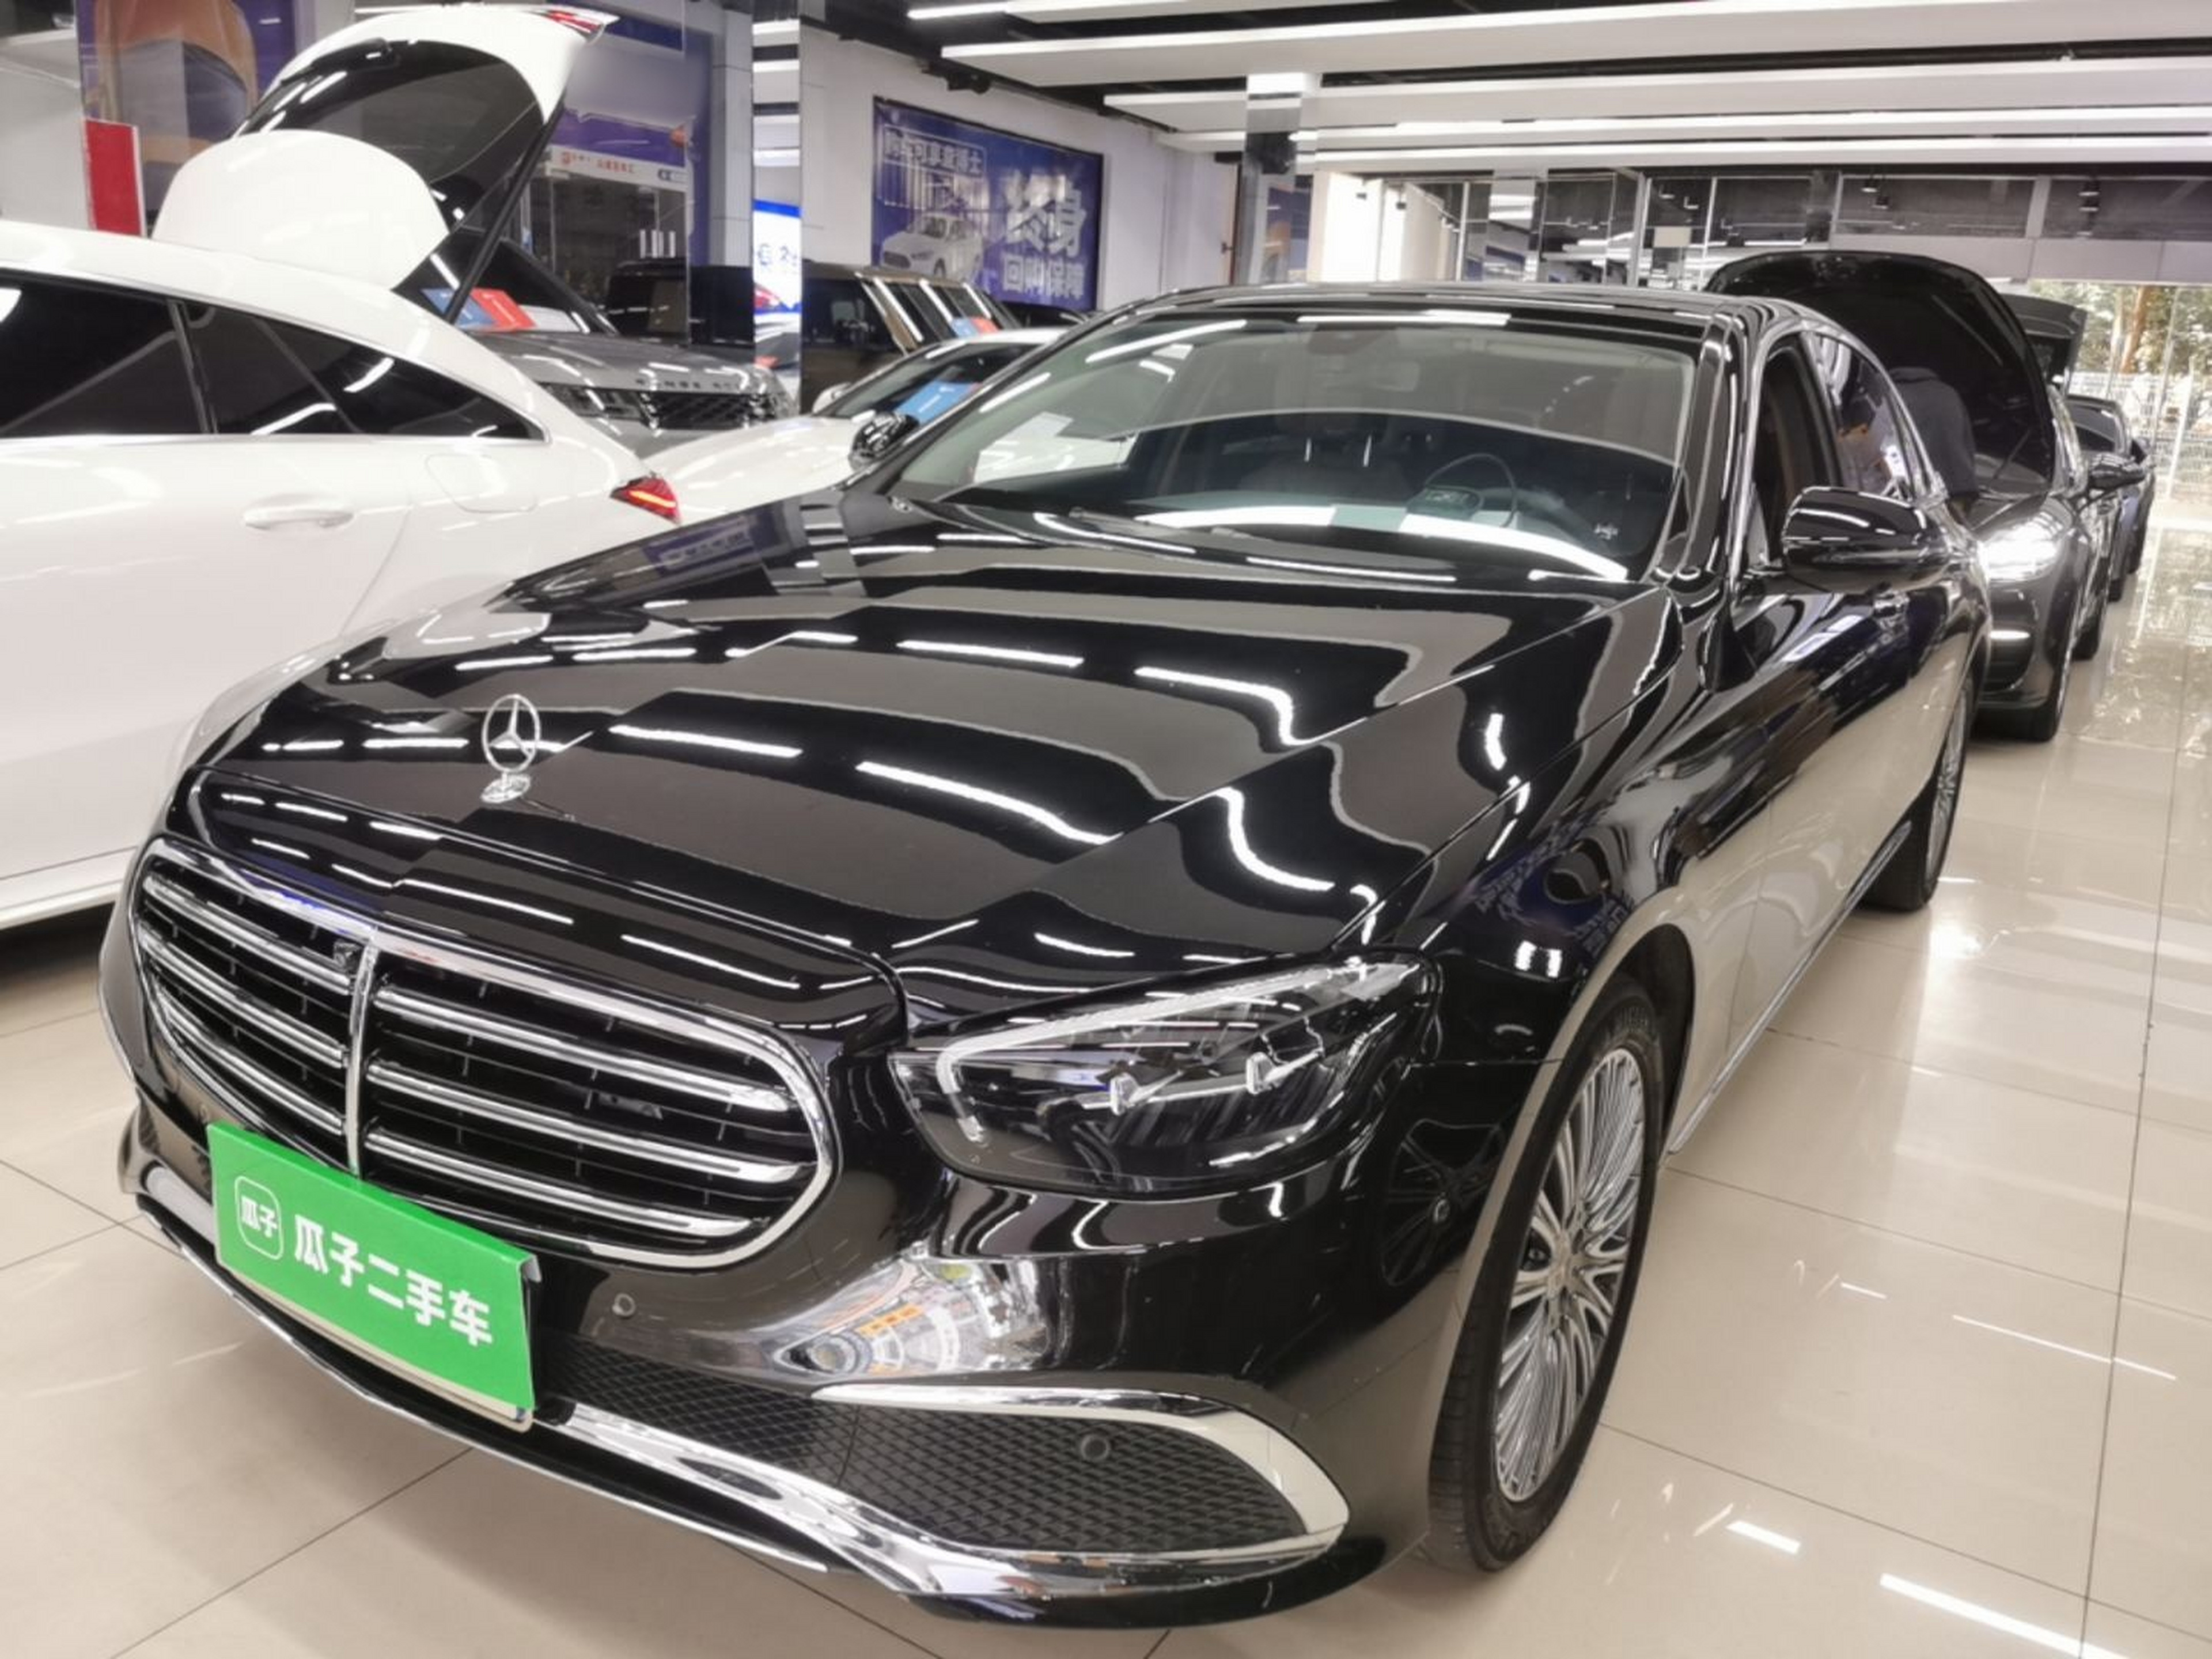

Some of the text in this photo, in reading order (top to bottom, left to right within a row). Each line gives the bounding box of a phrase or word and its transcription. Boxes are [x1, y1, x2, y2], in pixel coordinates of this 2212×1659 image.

[241, 1195, 278, 1238] 瓜子
[294, 1214, 493, 1346] 瓜子二手车
